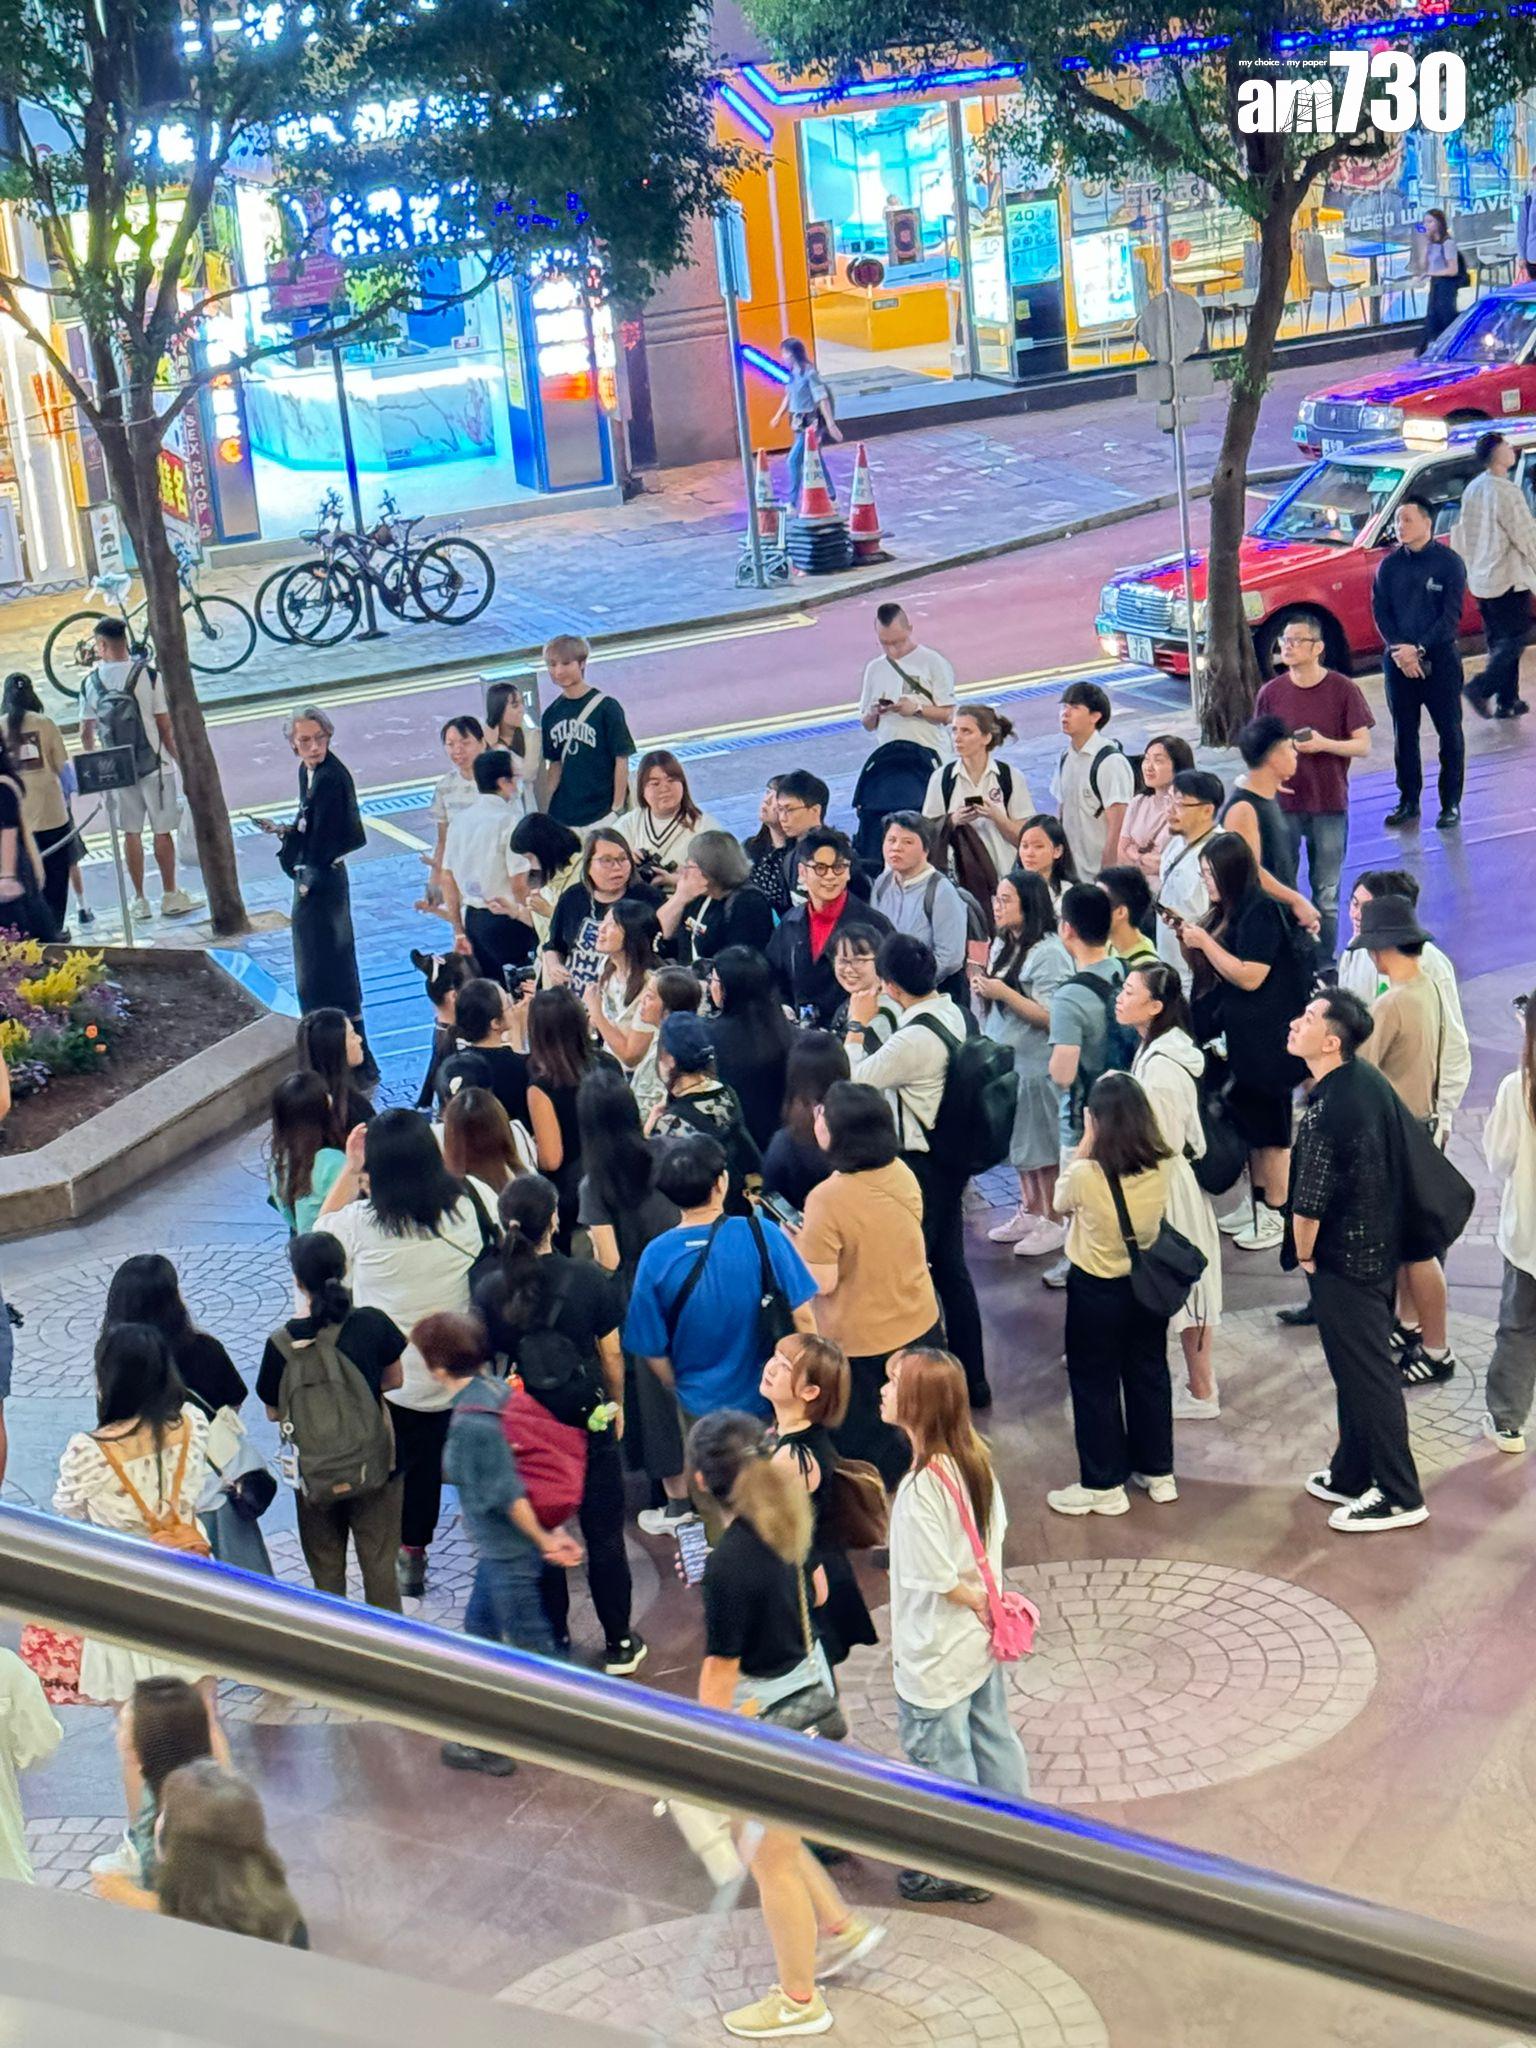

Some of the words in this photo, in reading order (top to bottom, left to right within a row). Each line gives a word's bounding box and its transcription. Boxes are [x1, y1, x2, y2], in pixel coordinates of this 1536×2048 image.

[1146, 187, 1161, 201] 12
[185, 414, 200, 455] SEX
[191, 461, 208, 515] SHOP
